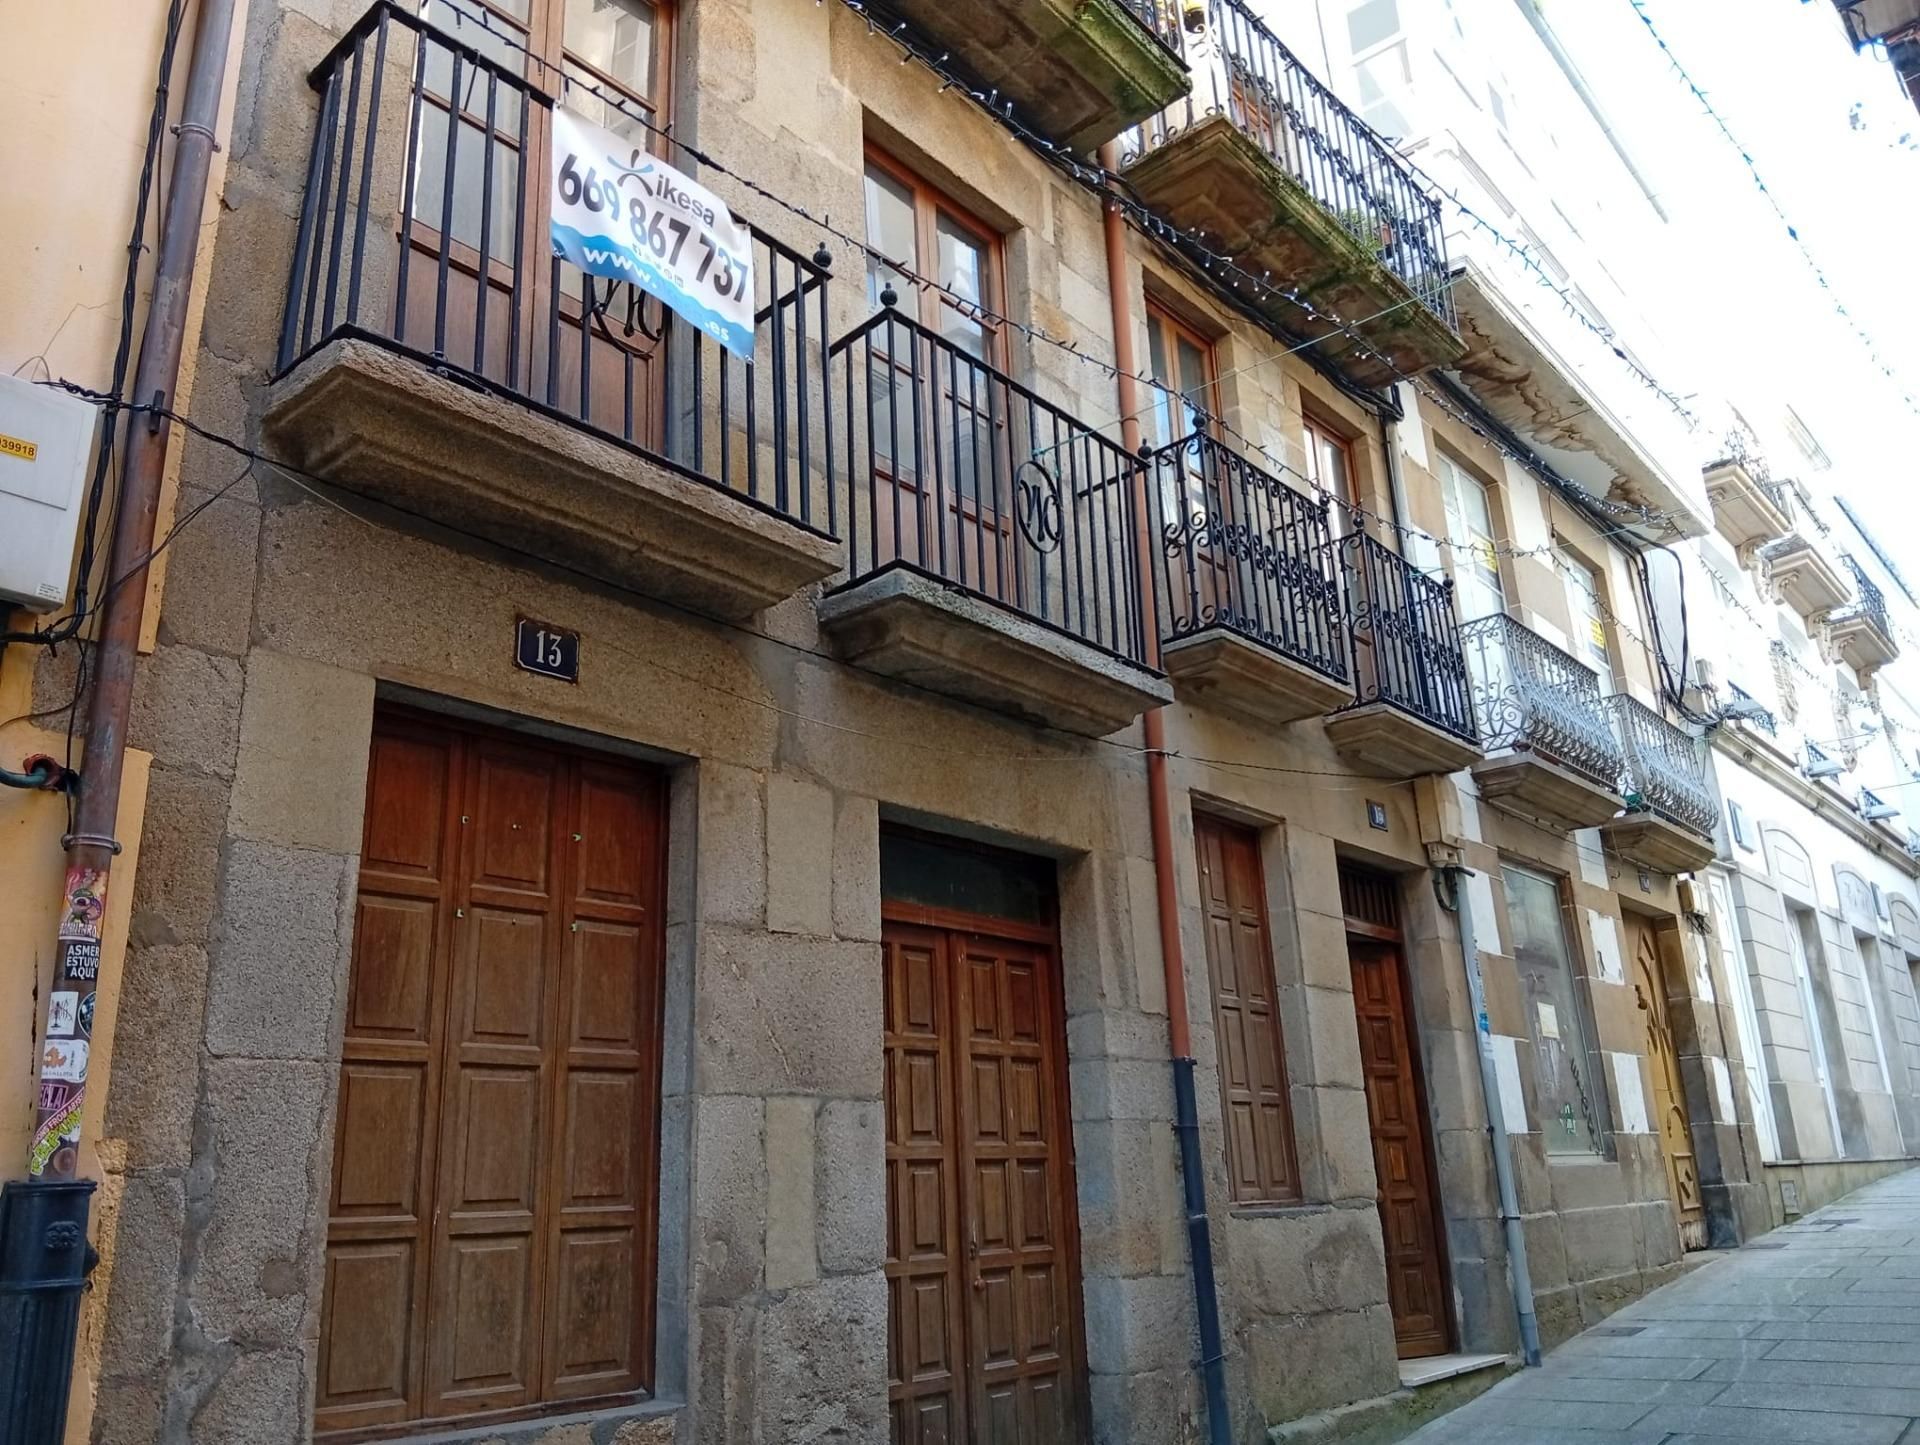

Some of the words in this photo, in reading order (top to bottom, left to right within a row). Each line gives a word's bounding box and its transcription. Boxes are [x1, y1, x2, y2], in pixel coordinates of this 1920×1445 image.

[559, 155, 620, 222] 669
[629, 197, 691, 267] 867
[695, 233, 749, 303] 737
[536, 630, 562, 667] 13
[66, 956, 99, 968] ESTUVO
[70, 967, 95, 980] AQUI
[48, 1110, 67, 1129] FROM
